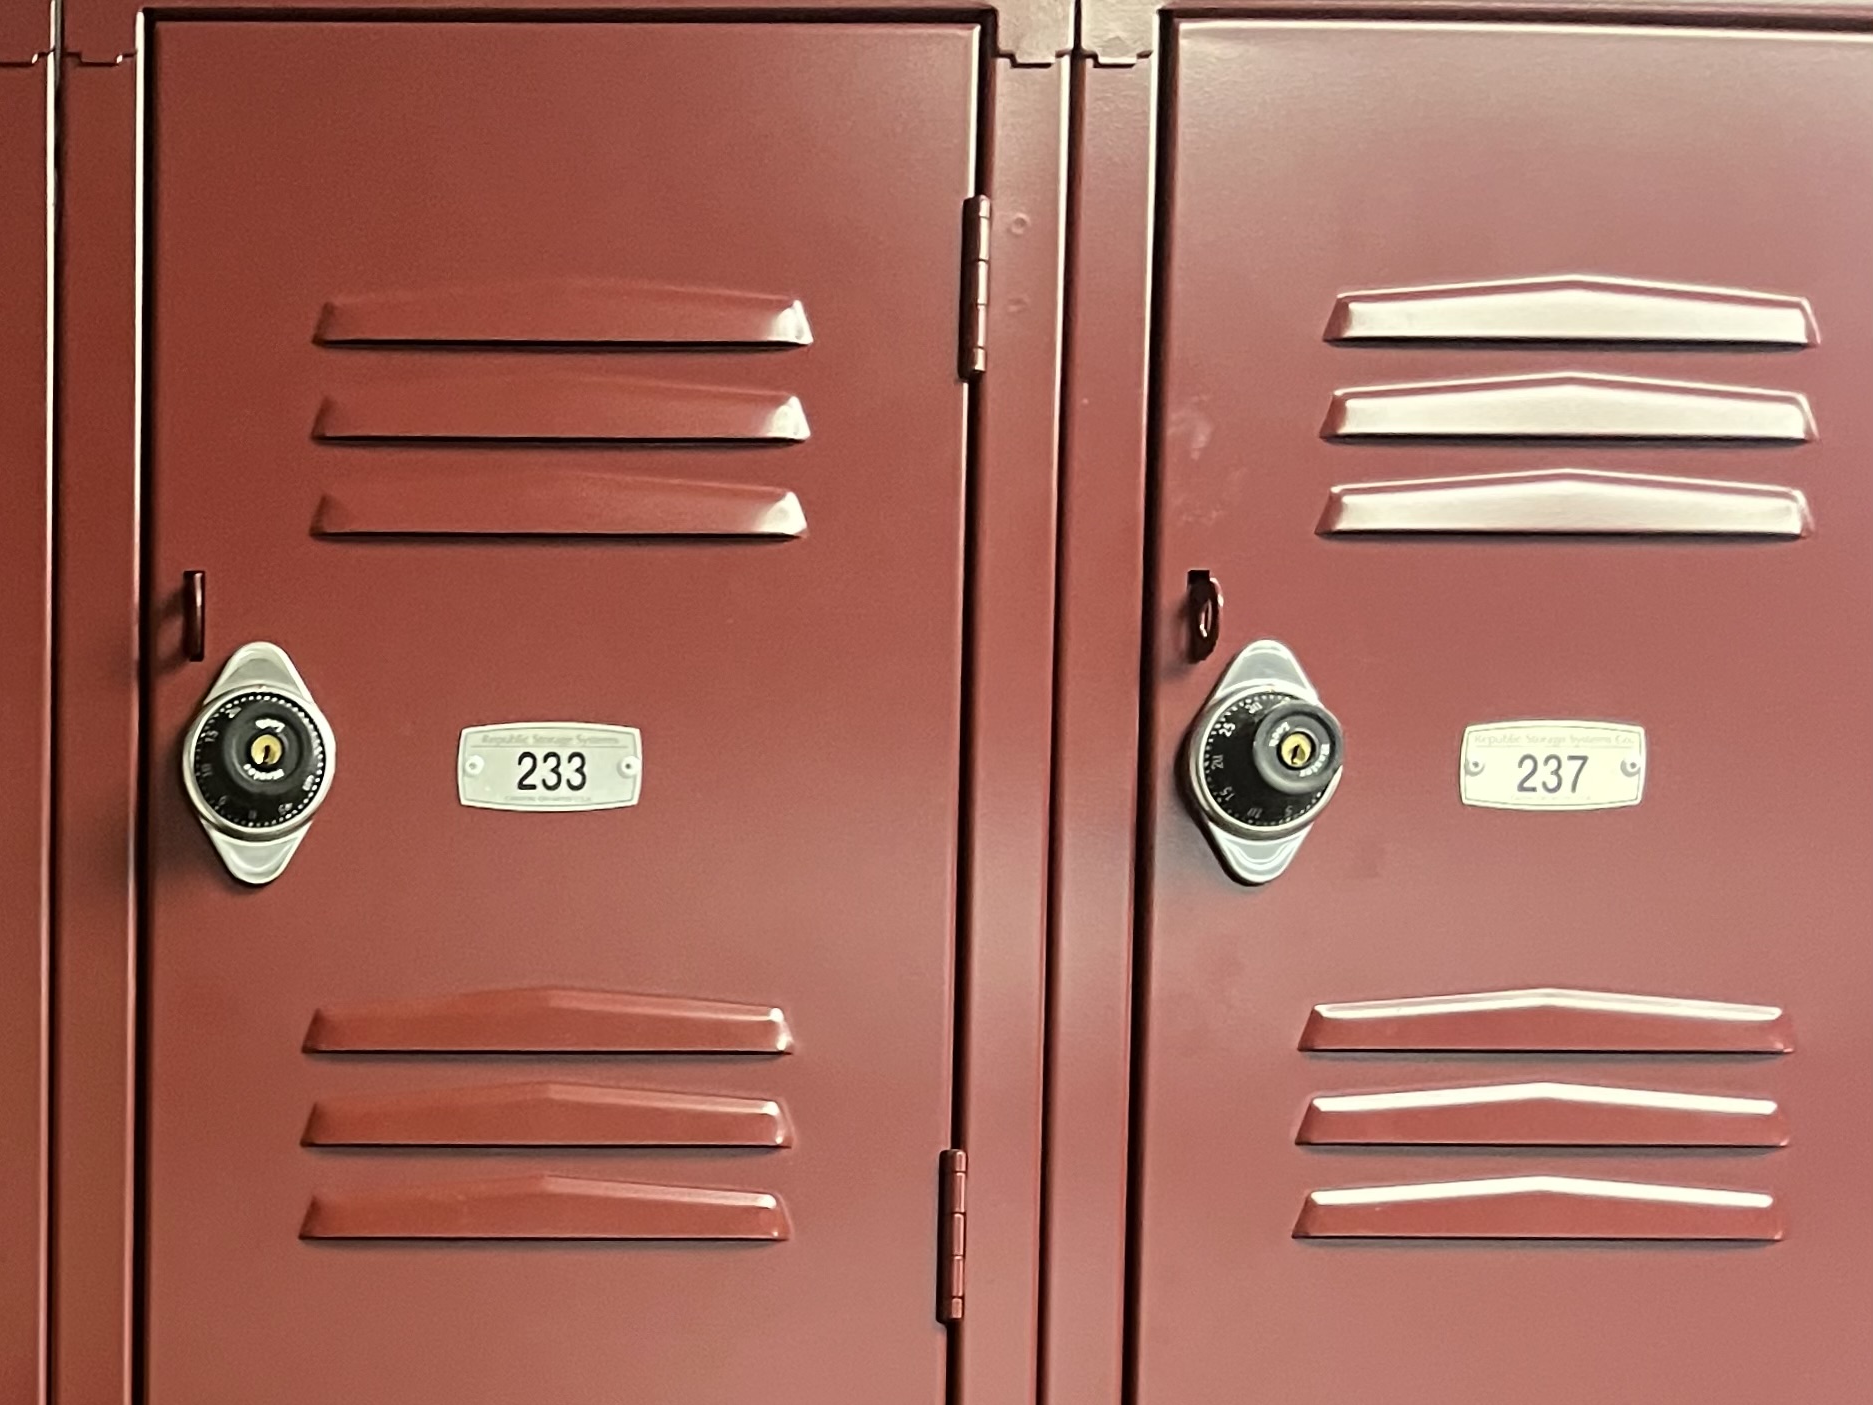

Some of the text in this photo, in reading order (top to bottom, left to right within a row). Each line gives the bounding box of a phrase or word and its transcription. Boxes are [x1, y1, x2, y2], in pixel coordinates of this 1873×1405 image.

[1218, 722, 1236, 737] 25
[516, 751, 588, 792] 233
[1516, 753, 1589, 794] 237
[1219, 786, 1236, 802] 15
